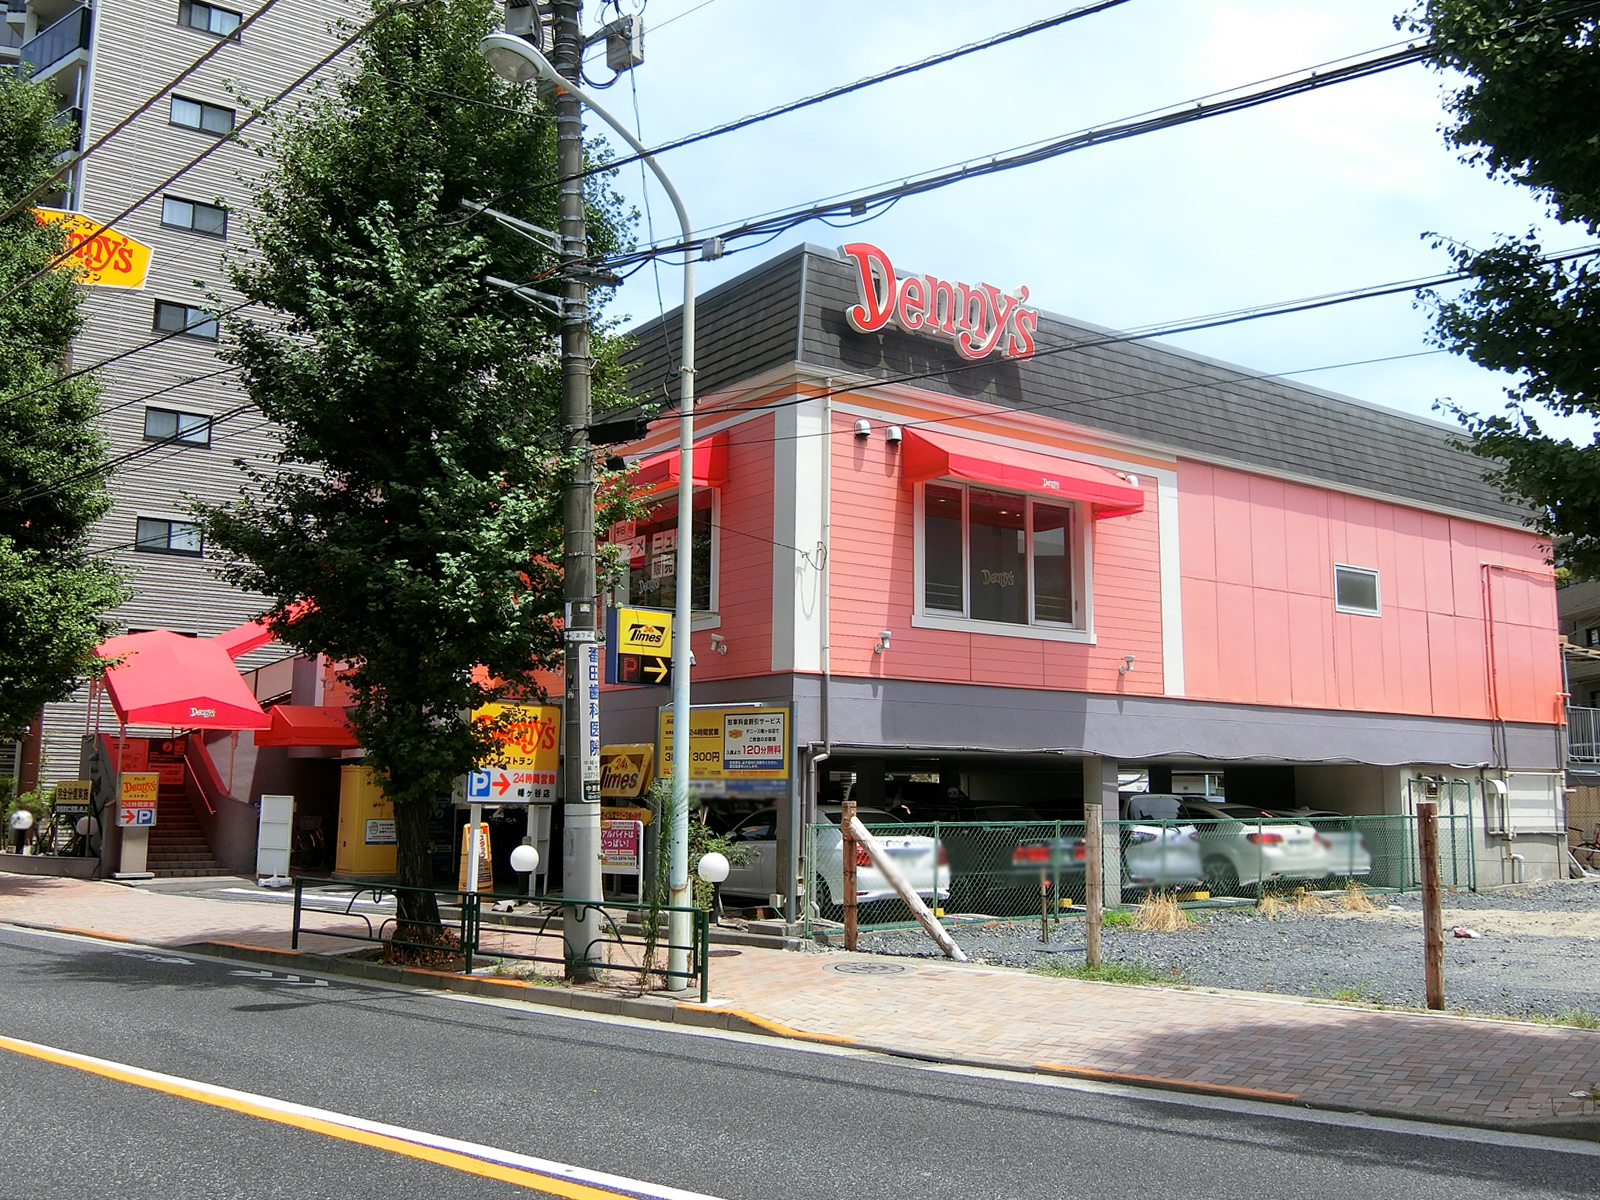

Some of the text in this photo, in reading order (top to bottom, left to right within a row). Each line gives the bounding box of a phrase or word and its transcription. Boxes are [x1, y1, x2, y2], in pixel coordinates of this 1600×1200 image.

[838, 242, 1037, 361] Denny's
[981, 569, 1014, 588] Denny's
[629, 624, 664, 643] Times
[190, 706, 216, 718] Denny's
[742, 745, 781, 755] 120分無料
[692, 752, 719, 762] 300円
[512, 773, 555, 785] 24時間営業
[123, 781, 157, 794] Denny's
